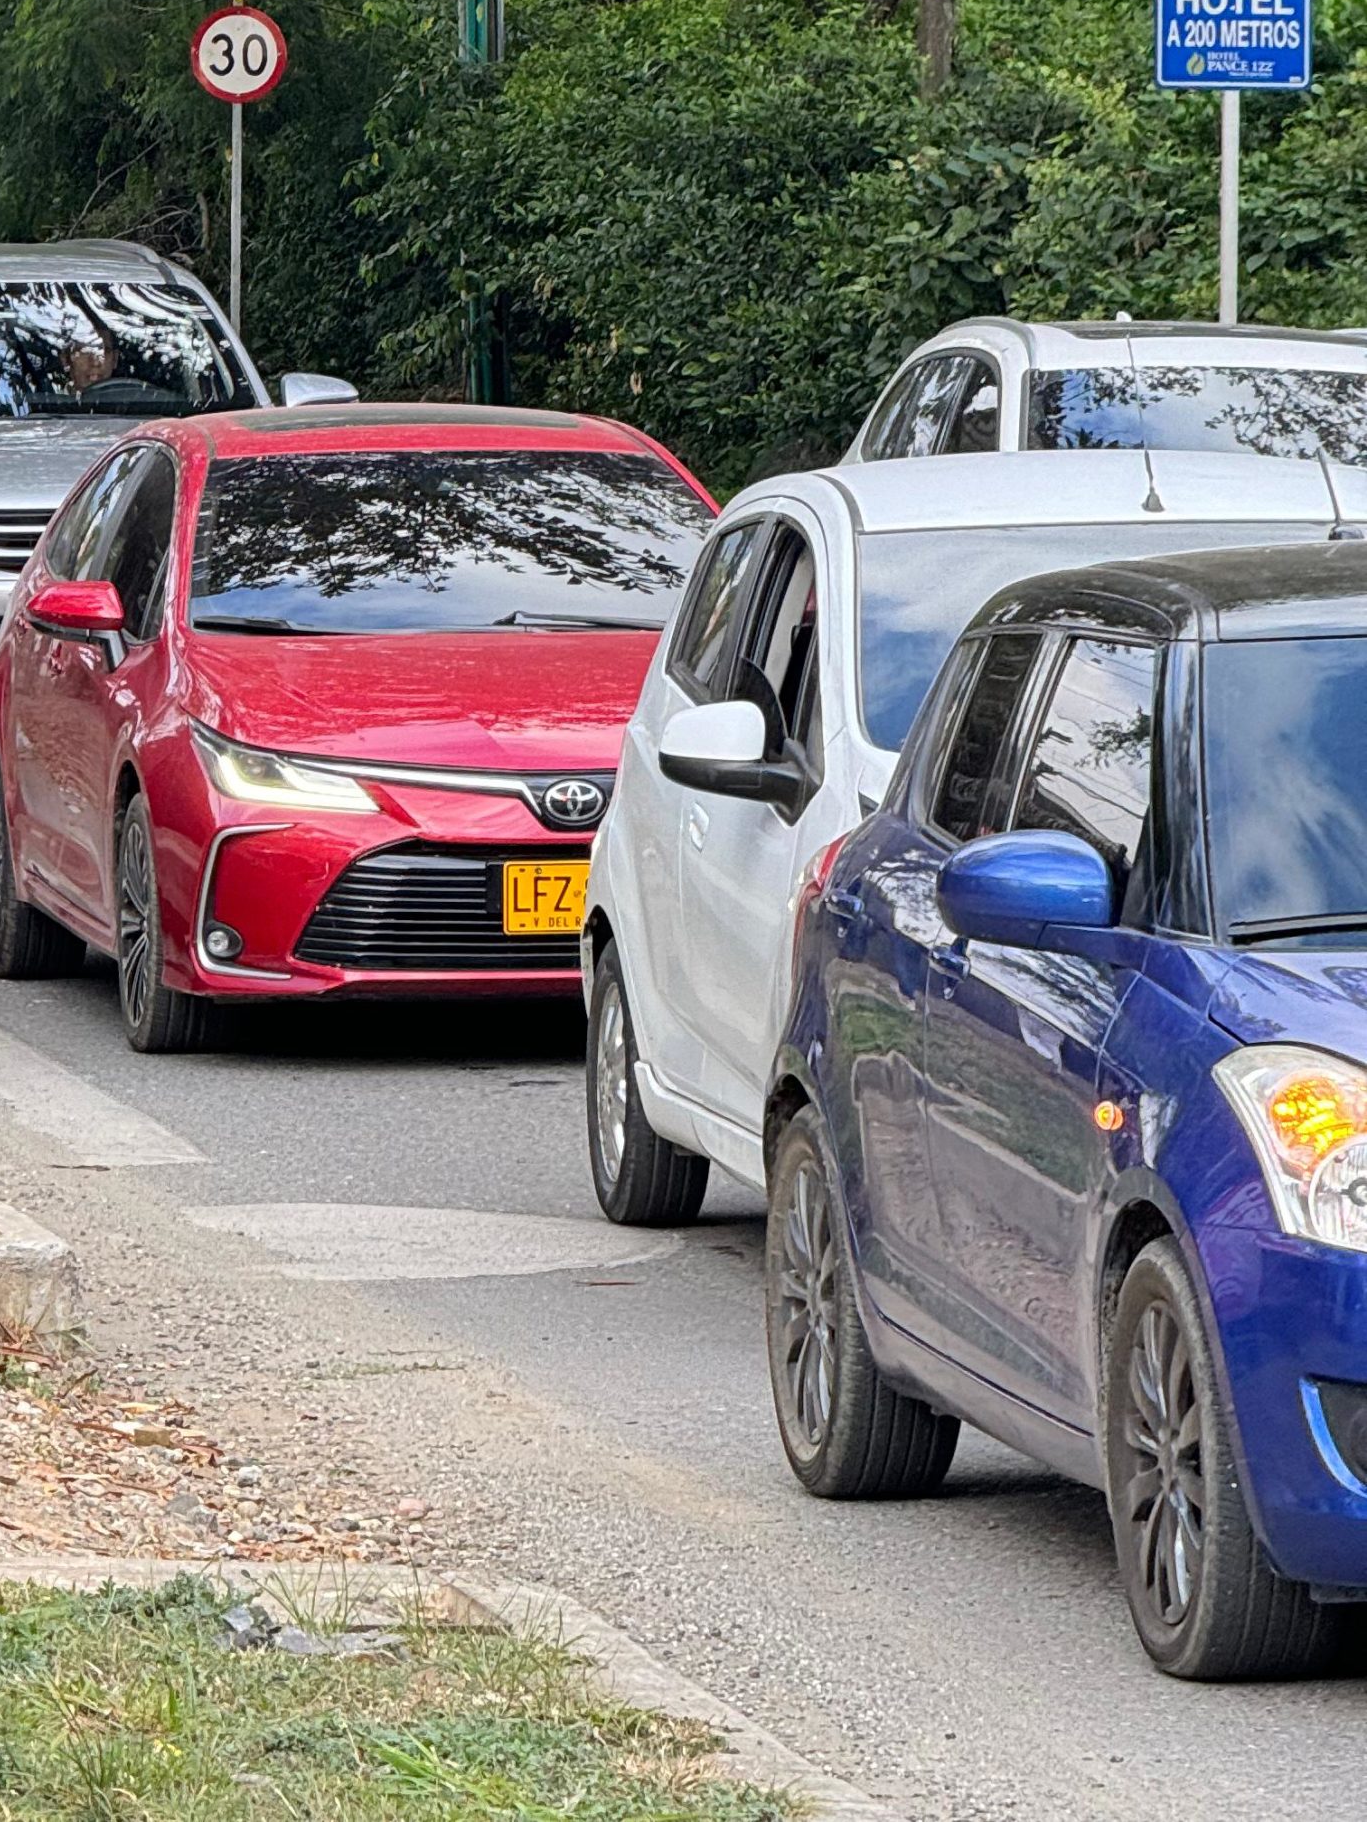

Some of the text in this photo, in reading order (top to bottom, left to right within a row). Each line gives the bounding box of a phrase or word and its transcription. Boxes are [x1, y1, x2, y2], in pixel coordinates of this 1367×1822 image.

[1166, 19, 1300, 49] A 200 METROS
[209, 33, 268, 77] 30
[1207, 51, 1240, 61] HOTEL
[1207, 60, 1249, 72] PANCE
[513, 876, 572, 913] LFZ
[548, 917, 569, 927] DEL
